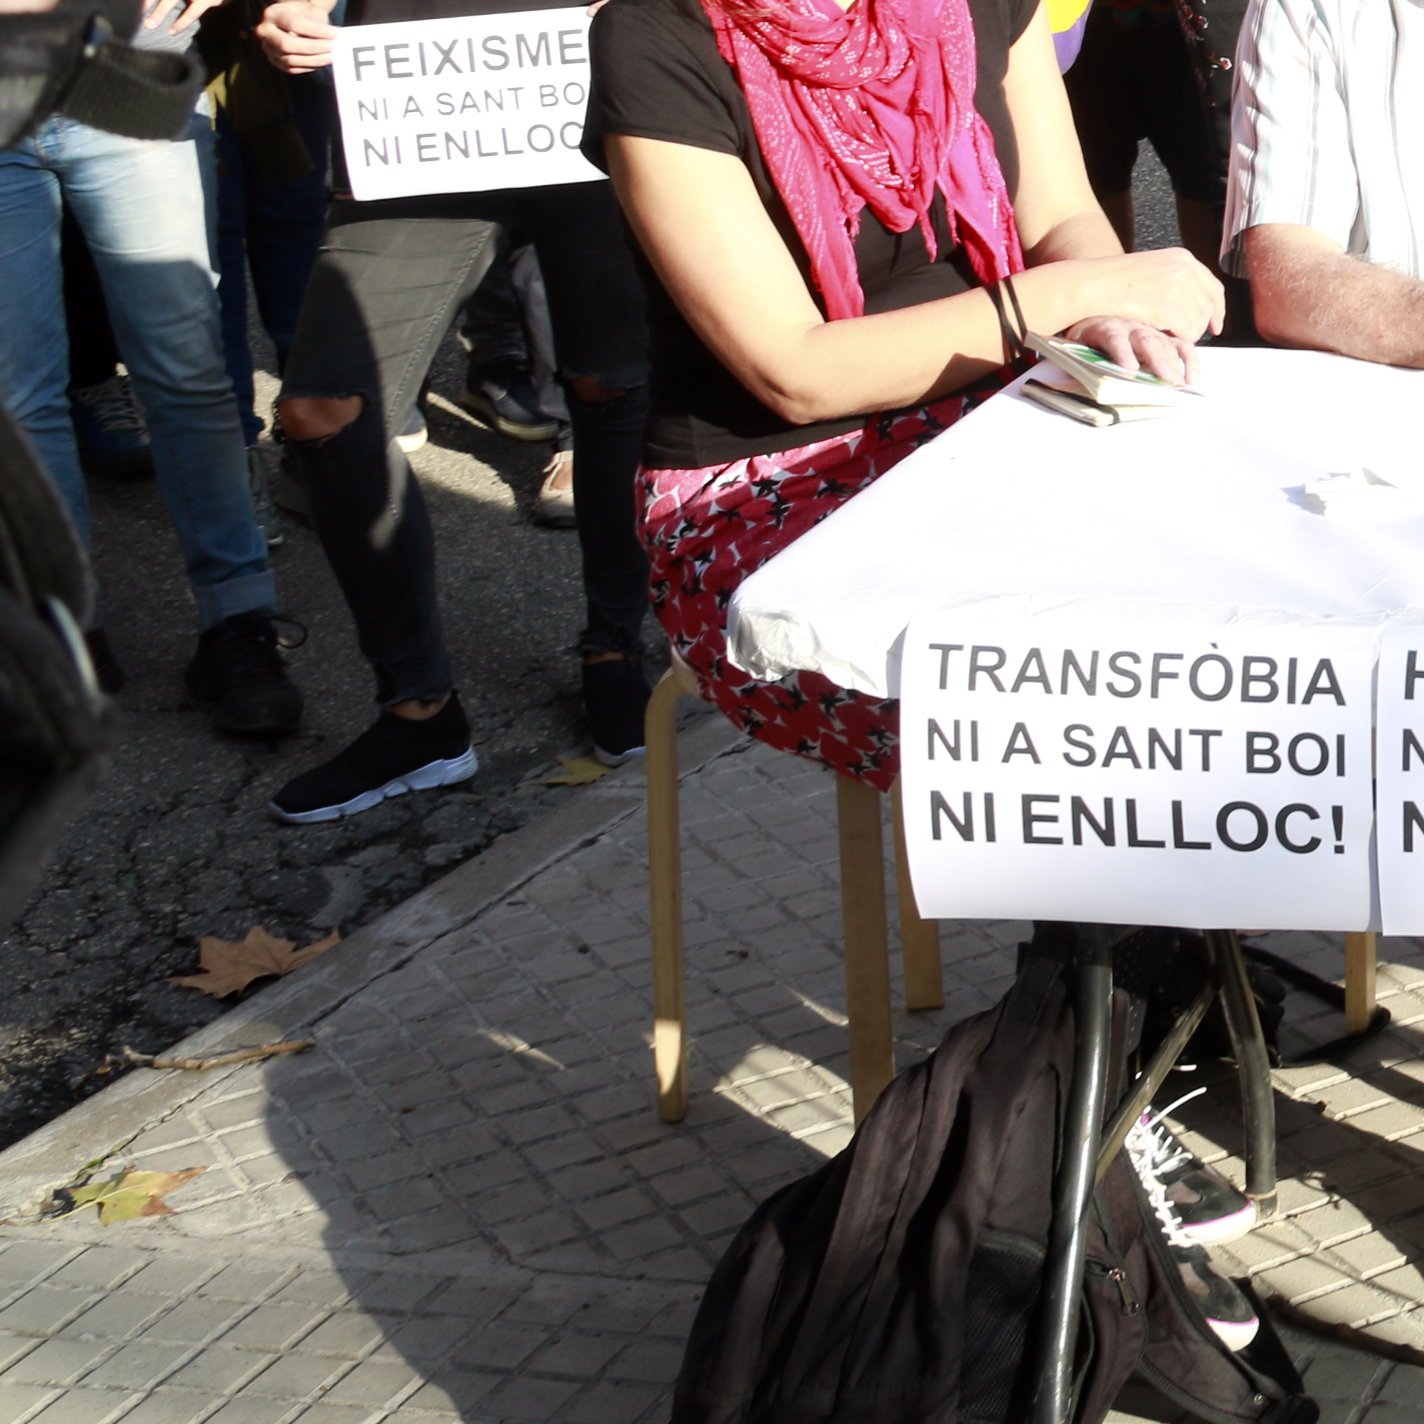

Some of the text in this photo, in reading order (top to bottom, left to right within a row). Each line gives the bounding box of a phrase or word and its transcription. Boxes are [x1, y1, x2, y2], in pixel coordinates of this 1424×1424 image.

[352, 29, 587, 81] FEIXISME
[358, 87, 524, 121] NI A SANT
[929, 643, 1347, 706] TRANSFÒBIA
[928, 718, 1345, 777] NI A SANT BOI
[930, 790, 1345, 854] NI ENLLOC!
